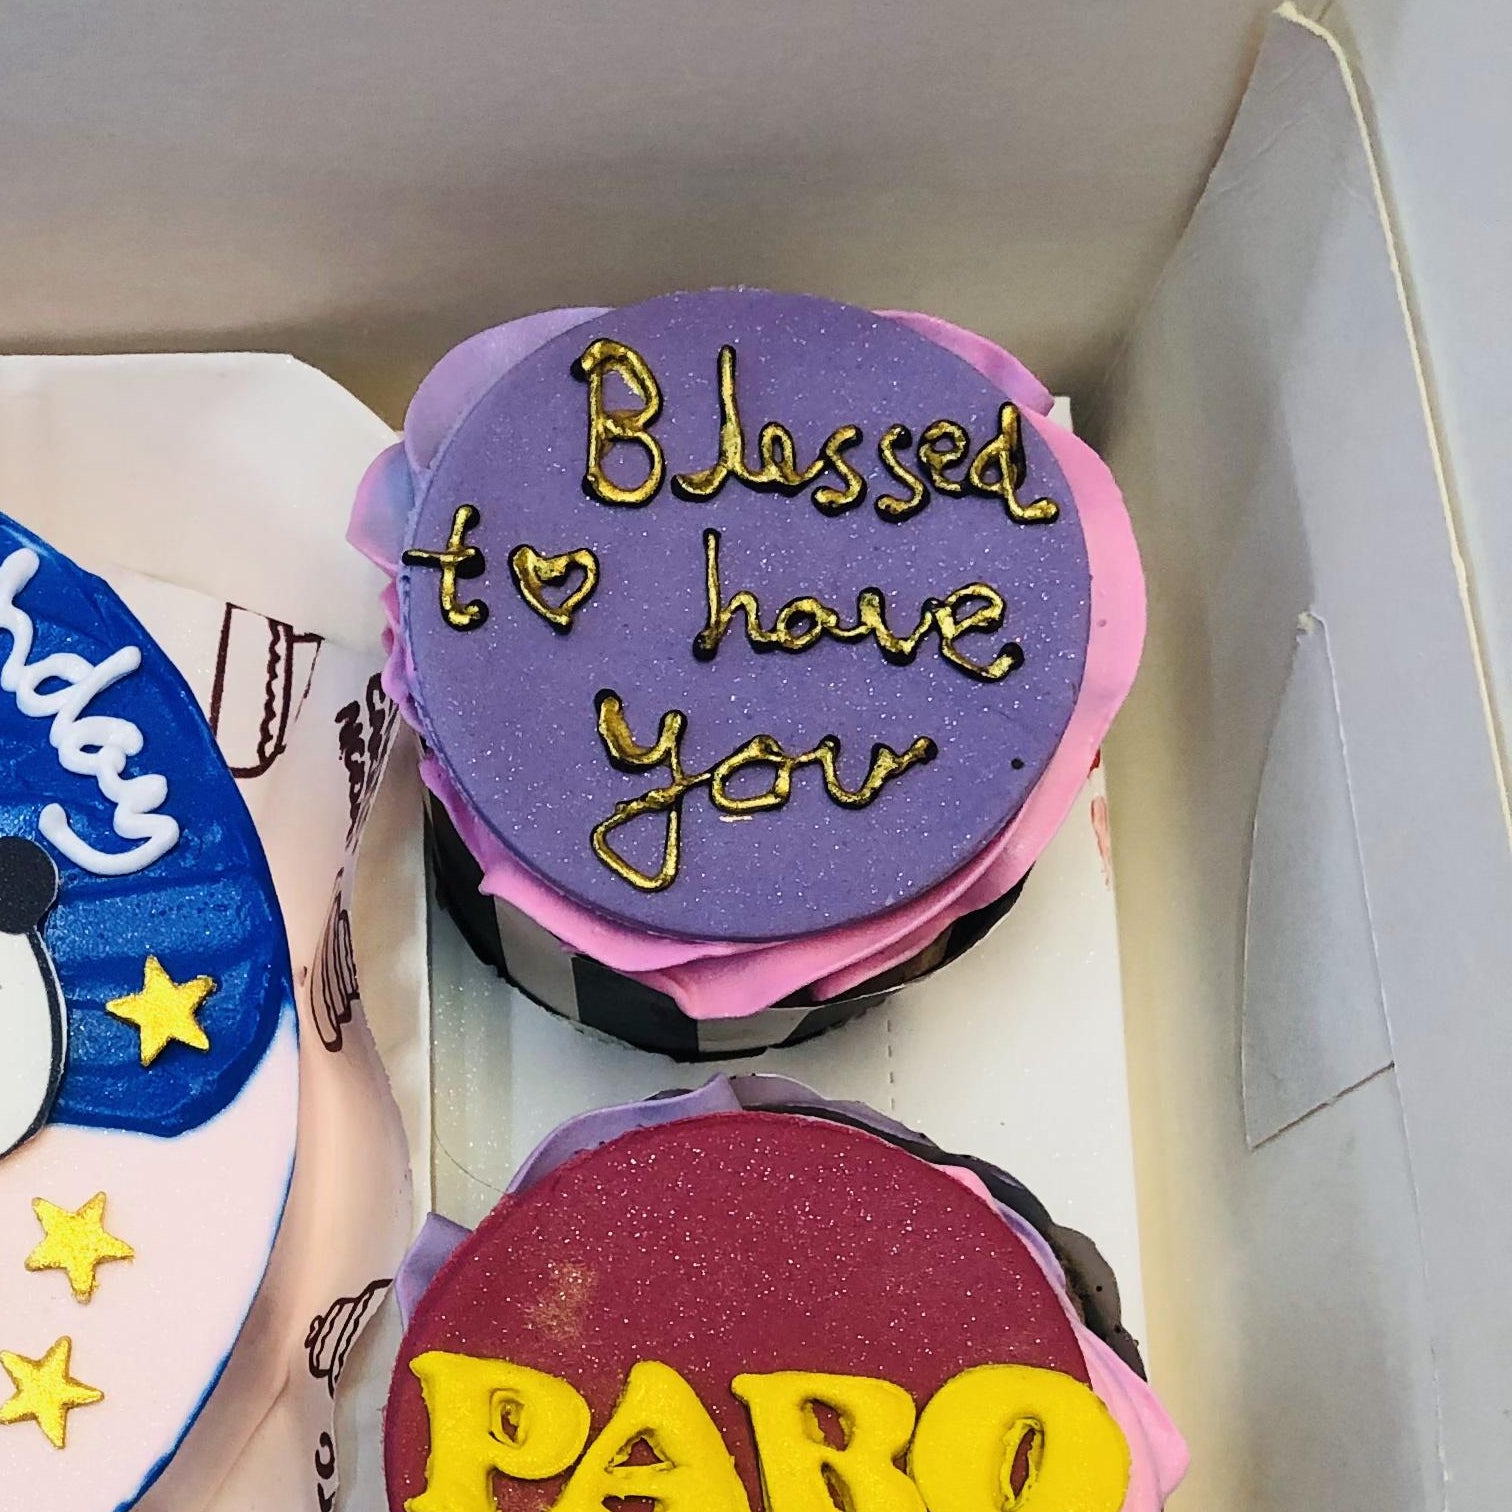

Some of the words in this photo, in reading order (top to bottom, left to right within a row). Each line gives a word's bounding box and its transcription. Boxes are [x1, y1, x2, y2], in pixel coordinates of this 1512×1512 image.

[570, 338, 1059, 524] Blessed
[692, 527, 1024, 681] have
[592, 688, 938, 892] you
